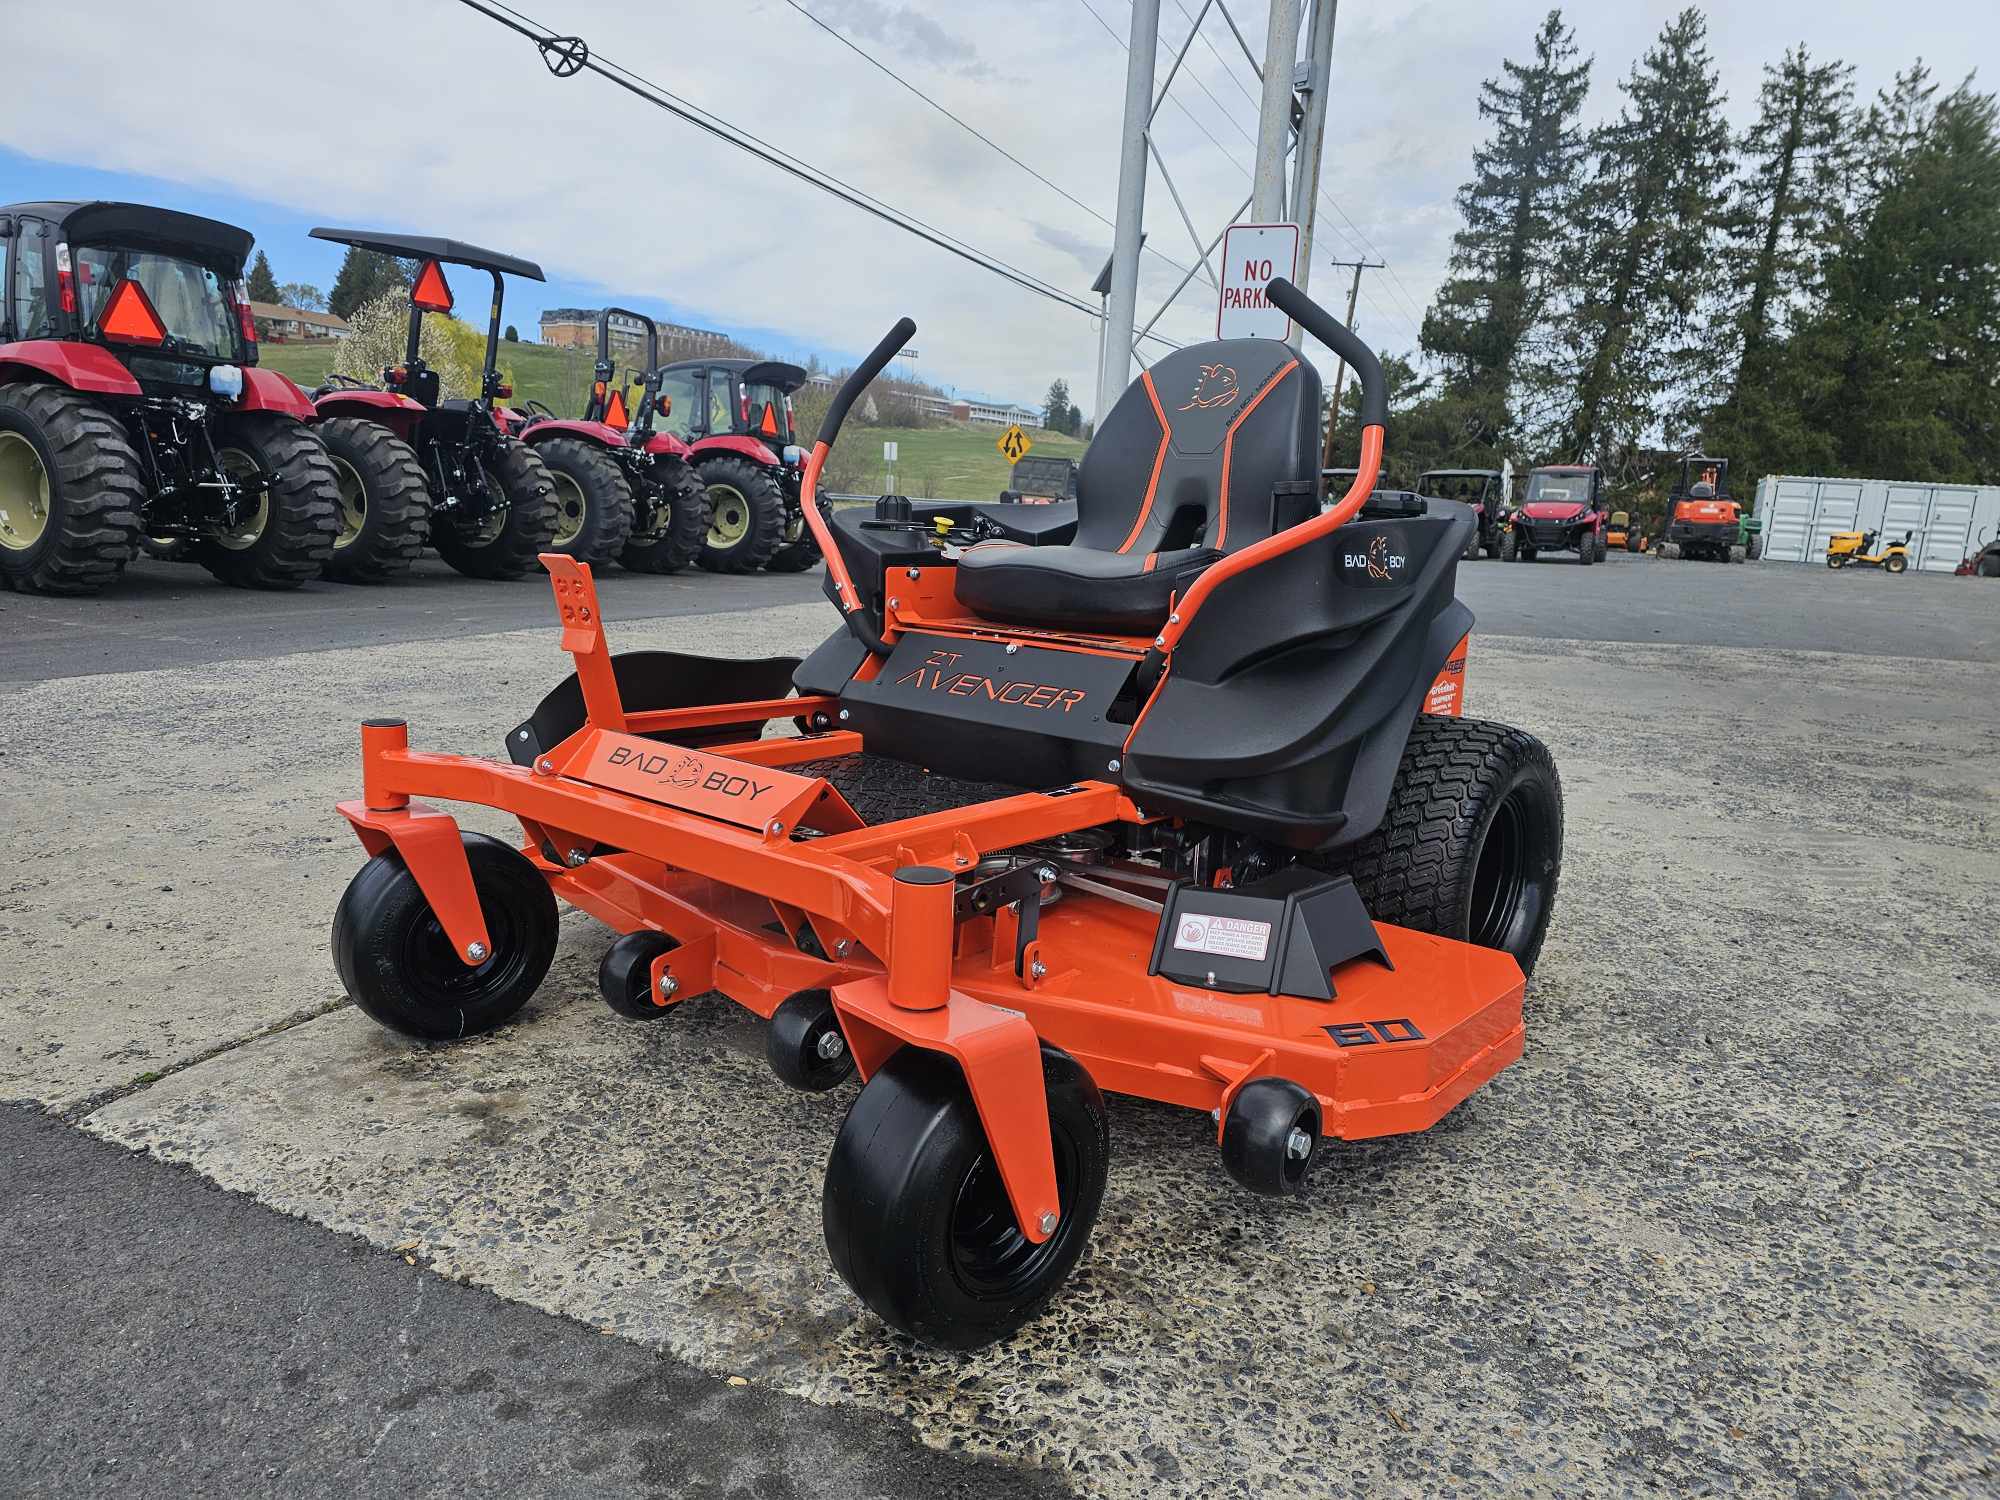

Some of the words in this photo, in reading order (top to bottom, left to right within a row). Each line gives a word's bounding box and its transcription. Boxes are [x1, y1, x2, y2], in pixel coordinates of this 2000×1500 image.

[1244, 259, 1272, 281] NO
[1223, 287, 1278, 309] PARKI
[1344, 554, 1367, 568] BAD
[1389, 555, 1406, 568] BOY
[926, 650, 964, 667] ZT
[895, 667, 1088, 713] AVENGER
[607, 746, 668, 775] BAD
[702, 771, 774, 801] BOY
[1226, 919, 1267, 936] DANGER
[1320, 1018, 1426, 1047] 60
